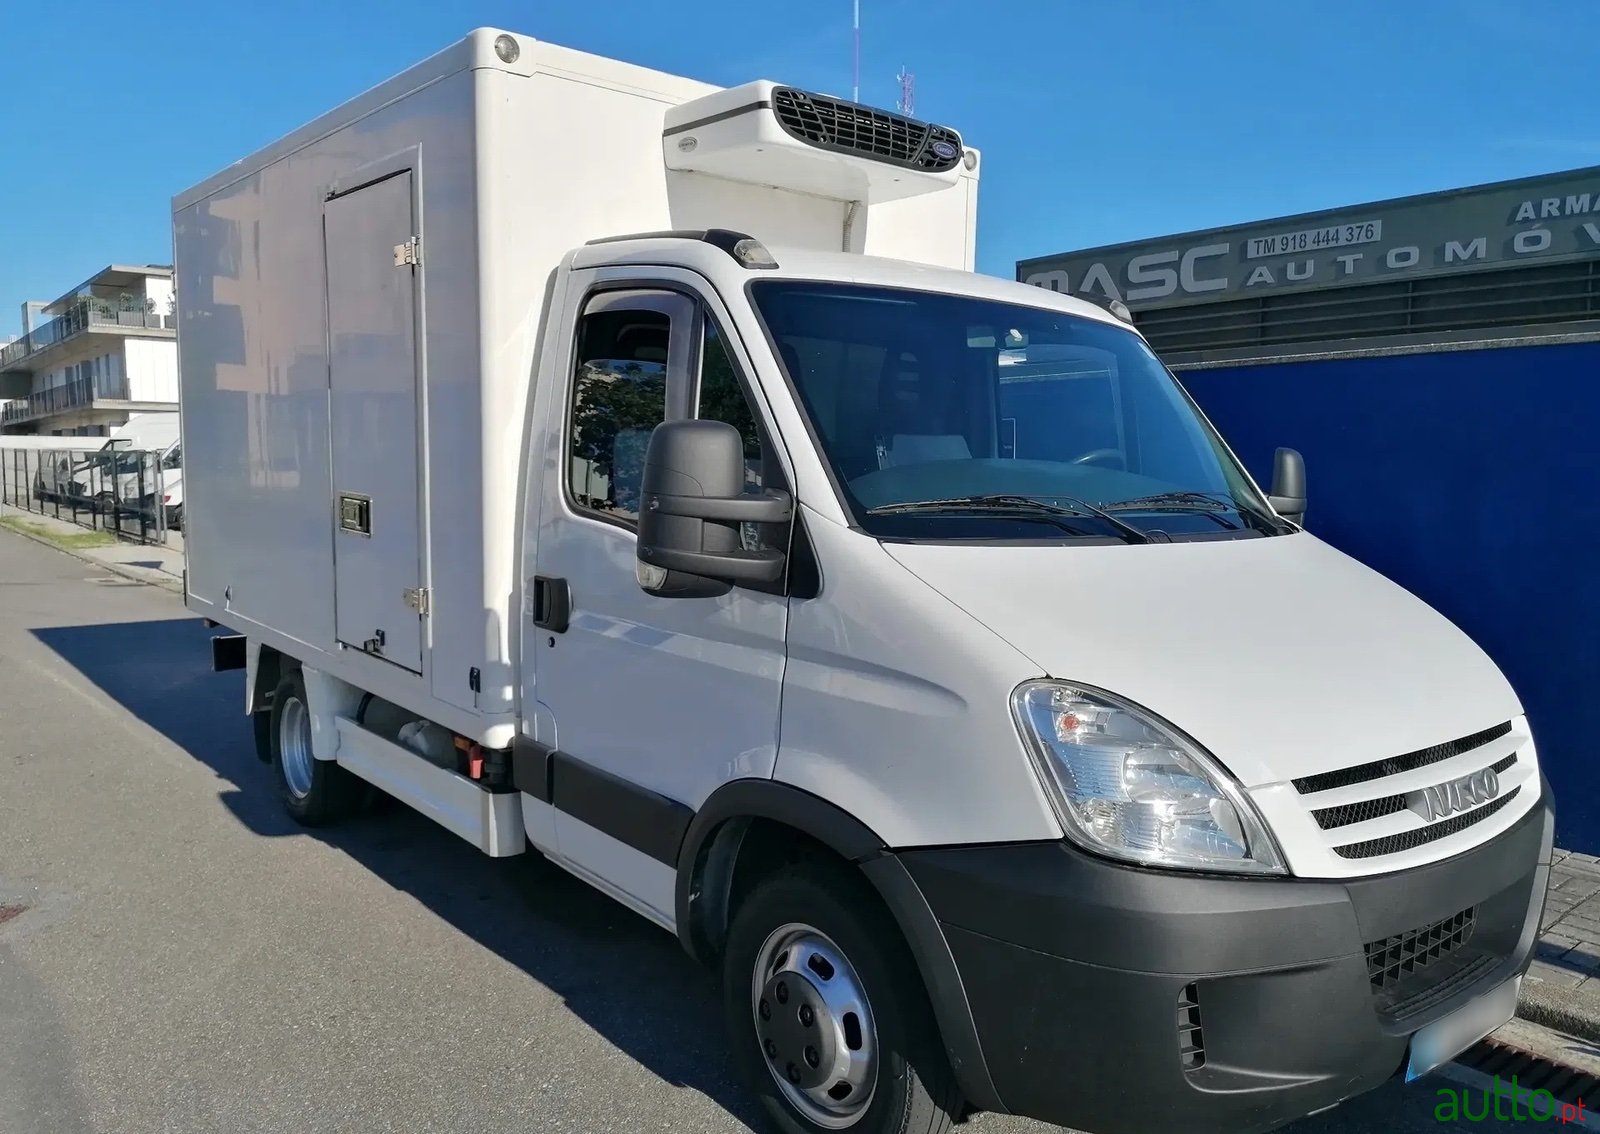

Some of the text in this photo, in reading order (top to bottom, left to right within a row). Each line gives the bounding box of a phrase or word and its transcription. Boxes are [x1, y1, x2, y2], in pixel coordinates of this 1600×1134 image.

[1253, 223, 1375, 256] TM 918 444 376
[1422, 767, 1500, 823] IVECO
